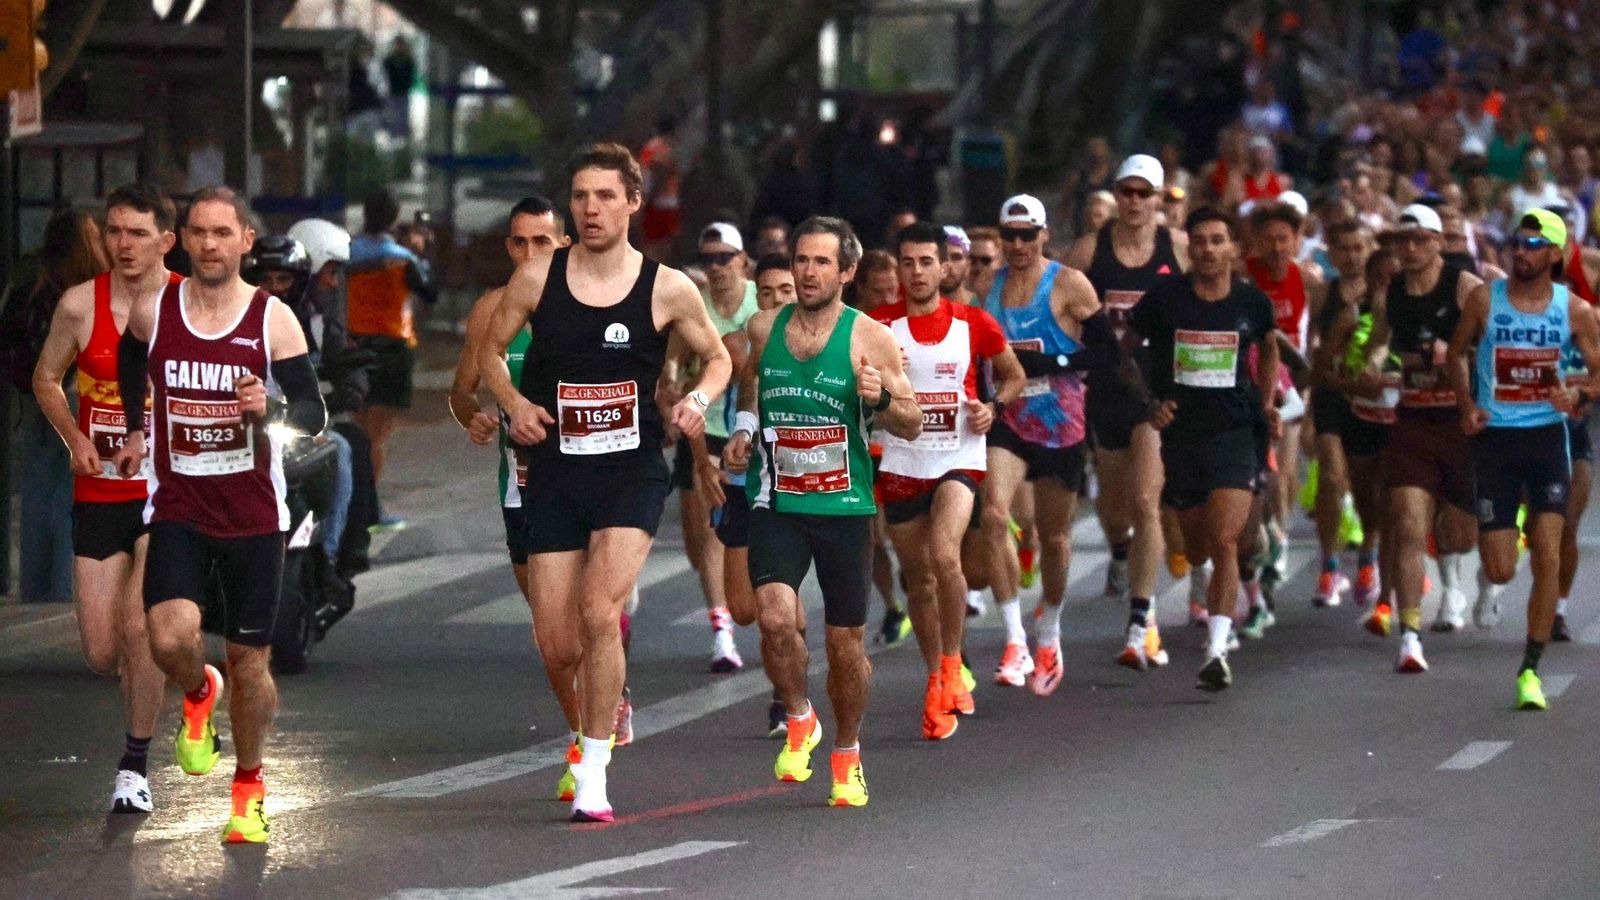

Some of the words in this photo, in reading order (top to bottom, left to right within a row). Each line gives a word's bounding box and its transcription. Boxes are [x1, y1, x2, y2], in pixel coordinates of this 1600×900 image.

[1496, 324, 1560, 347] nerja
[578, 386, 630, 398] GENERALI
[917, 394, 954, 403] ENERALI
[187, 404, 240, 417] GENERAL
[575, 409, 621, 423] 11626
[768, 411, 839, 424] ATLETISMO
[183, 427, 235, 442] 13623
[791, 429, 840, 441] GENERALI
[791, 450, 827, 464] 7903
